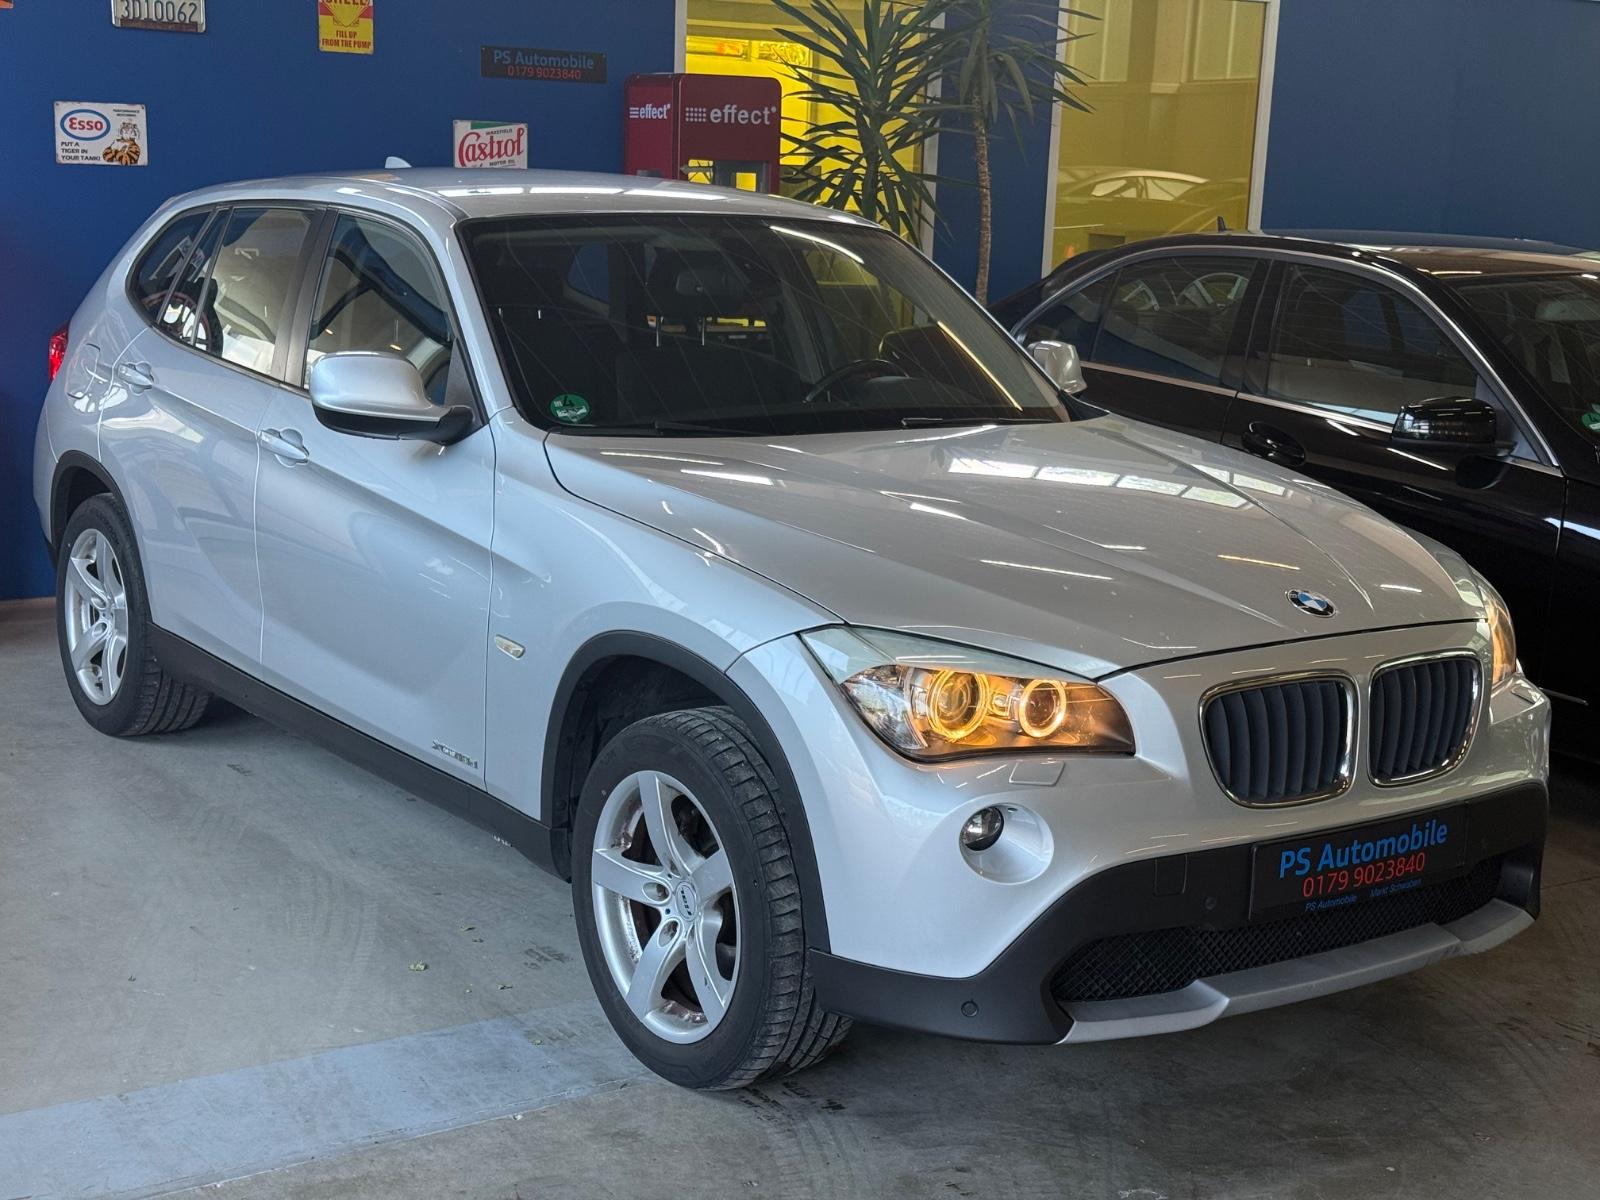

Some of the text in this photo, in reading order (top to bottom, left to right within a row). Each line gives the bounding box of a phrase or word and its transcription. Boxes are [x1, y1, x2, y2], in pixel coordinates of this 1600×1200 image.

[322, 38, 371, 49] FROM THE PUMP
[336, 30, 357, 39] FILL UP
[493, 50, 594, 69] PS Automobile
[507, 65, 582, 80] 0179 9023840
[639, 104, 668, 119] effect
[710, 105, 771, 125] effect
[458, 127, 524, 167] Castrol
[1279, 819, 1448, 878] PS Automobile
[1302, 852, 1426, 898] 0179 9023840
